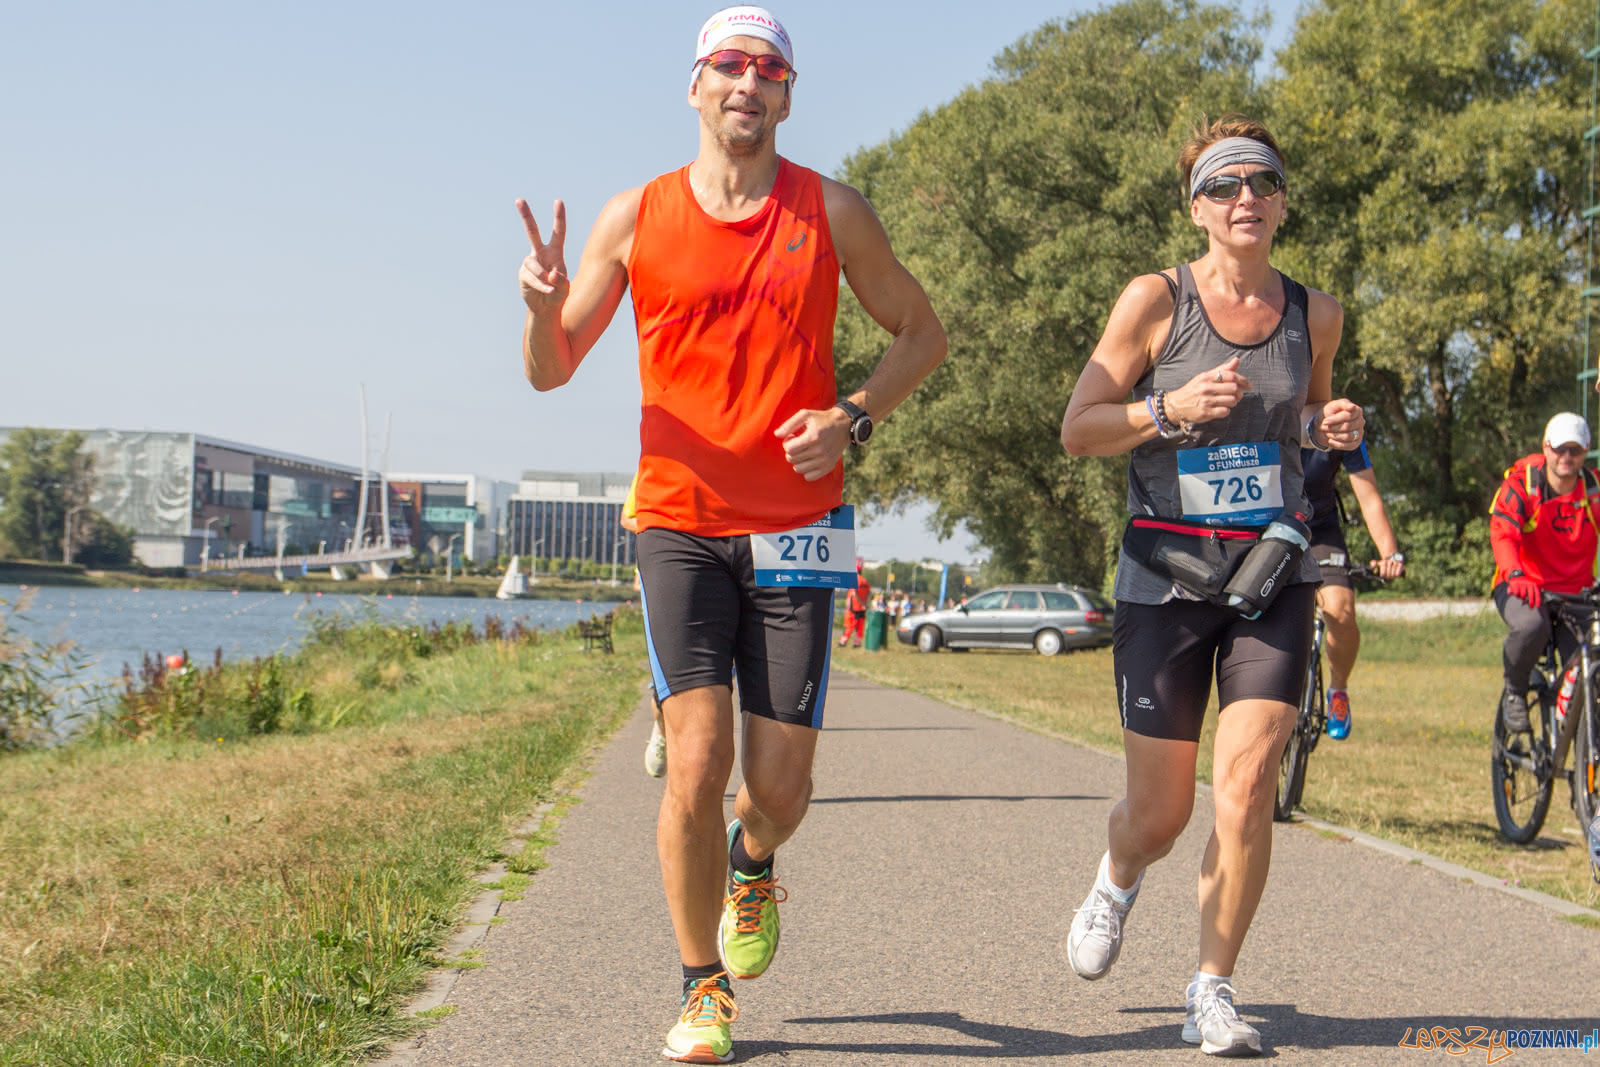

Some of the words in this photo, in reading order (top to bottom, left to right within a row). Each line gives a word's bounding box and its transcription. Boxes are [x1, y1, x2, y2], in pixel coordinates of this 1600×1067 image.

[1208, 445, 1258, 461] zaBIEGaj
[1216, 459, 1259, 469] FUNdusze
[1208, 475, 1263, 506] 726
[778, 535, 830, 563] 276
[797, 680, 814, 711] ACTIVE
